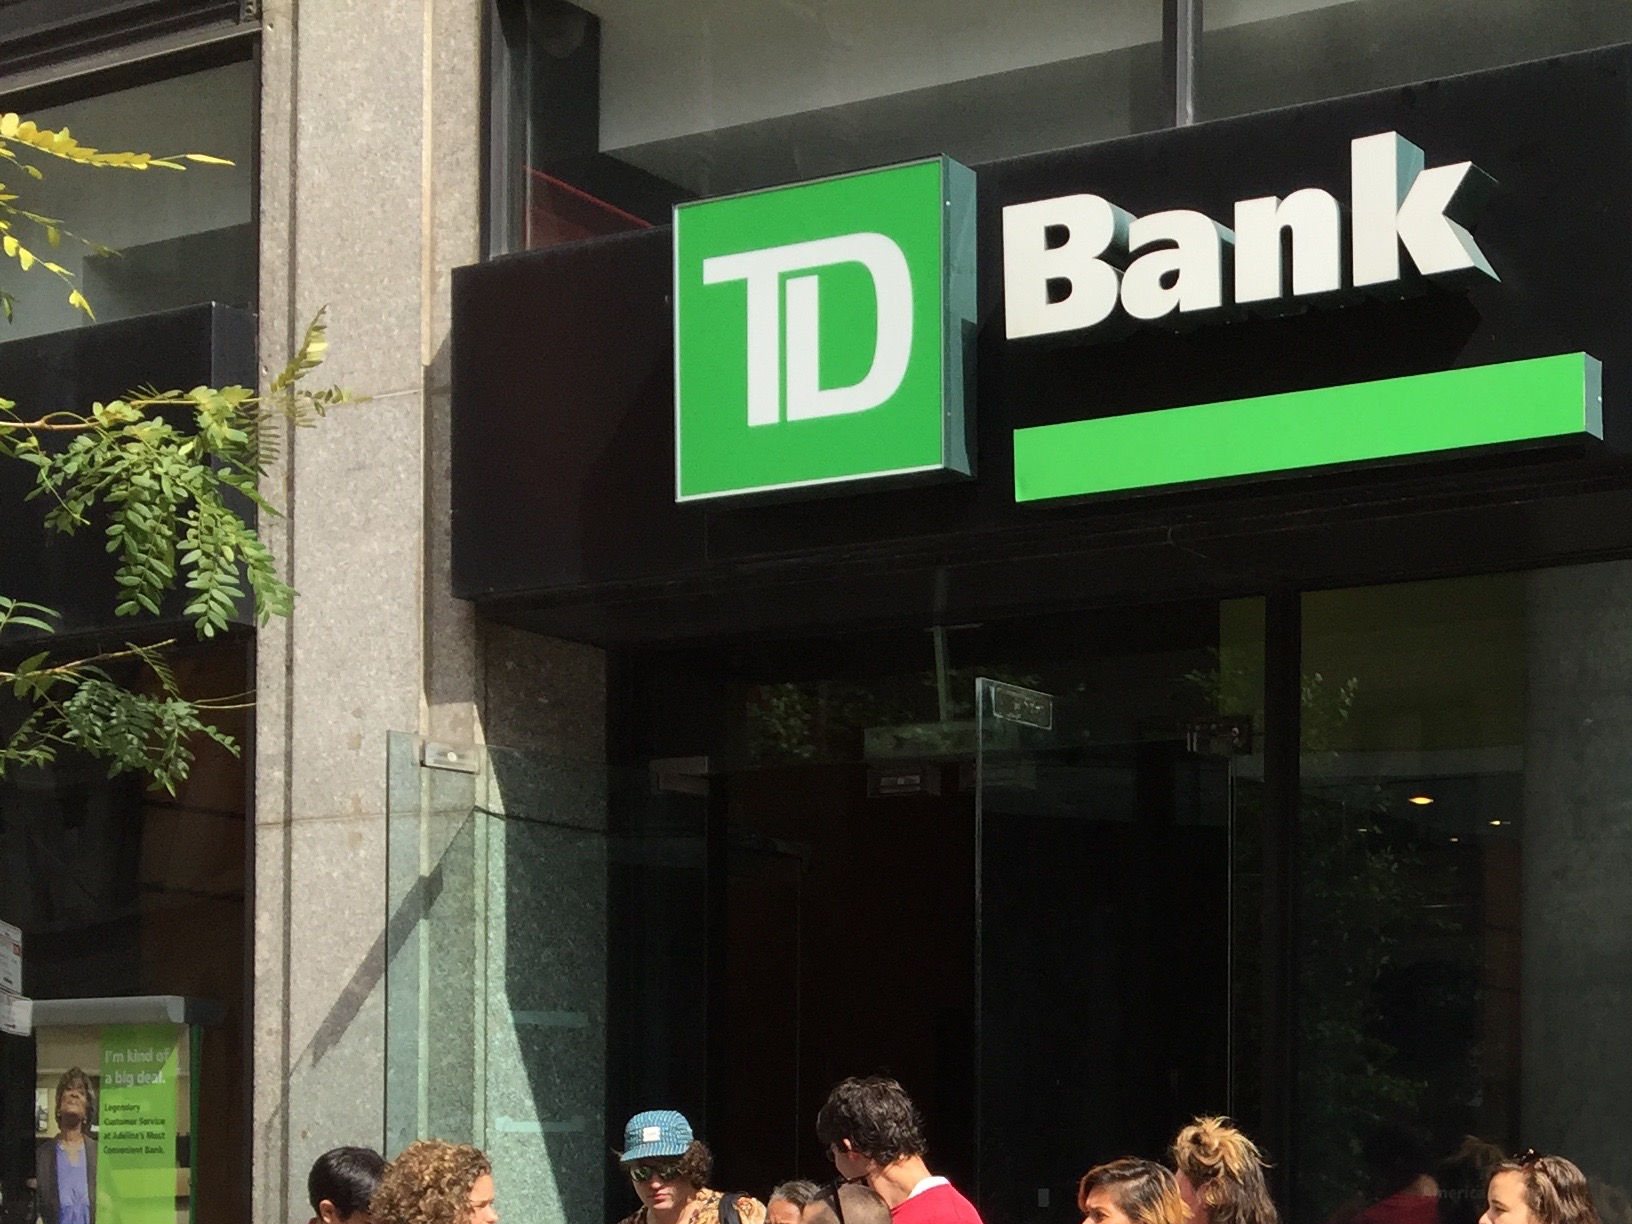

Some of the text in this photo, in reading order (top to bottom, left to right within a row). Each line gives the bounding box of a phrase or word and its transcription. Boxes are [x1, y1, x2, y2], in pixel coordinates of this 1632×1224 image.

[702, 130, 1490, 427] TD Bank
[105, 1047, 171, 1063] I'm kind of
[104, 1070, 166, 1088] a big deal.
[104, 1103, 141, 1114] Legendary
[103, 1117, 166, 1126] Customer Service
[102, 1145, 143, 1155] Convenient
